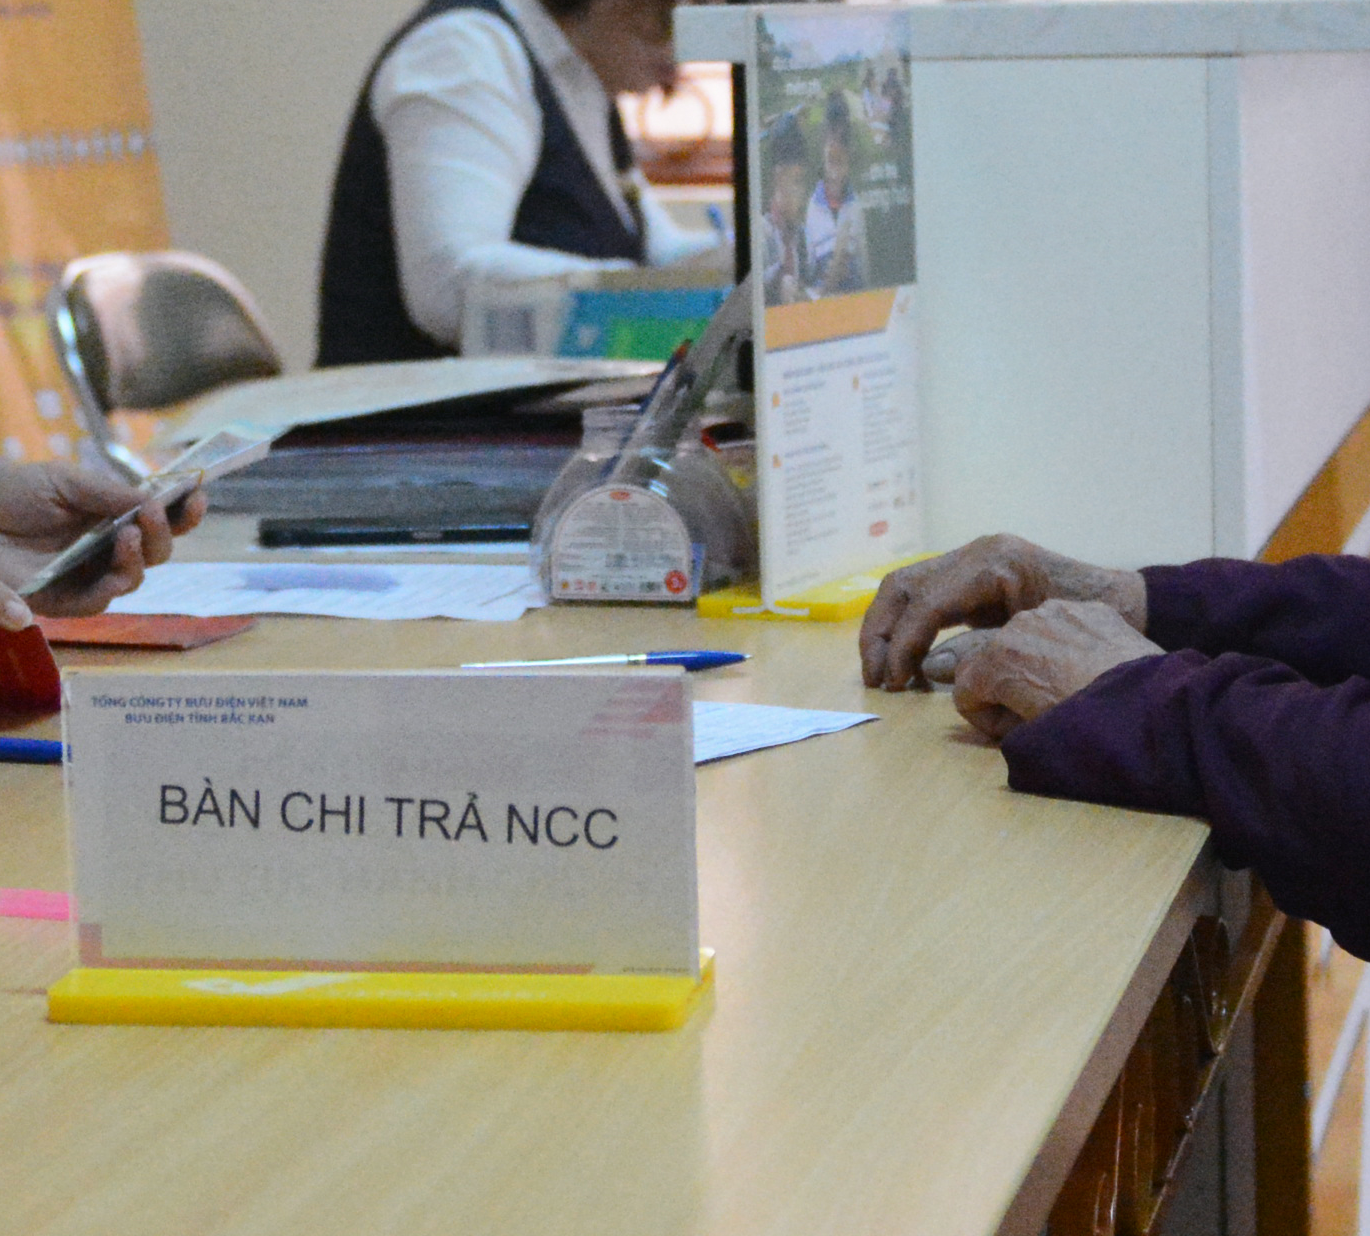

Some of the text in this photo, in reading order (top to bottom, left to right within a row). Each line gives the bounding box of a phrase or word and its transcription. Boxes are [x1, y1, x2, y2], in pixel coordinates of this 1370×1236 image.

[91, 693, 308, 711] TỔNG CÔNG TY BƯU ĐIỆN VIỆT NAM
[124, 711, 152, 724] BƯU
[154, 711, 185, 726] ĐIỆN
[220, 711, 245, 724] BẮC
[159, 776, 619, 851] BÀN CHI TRẢ NCC
